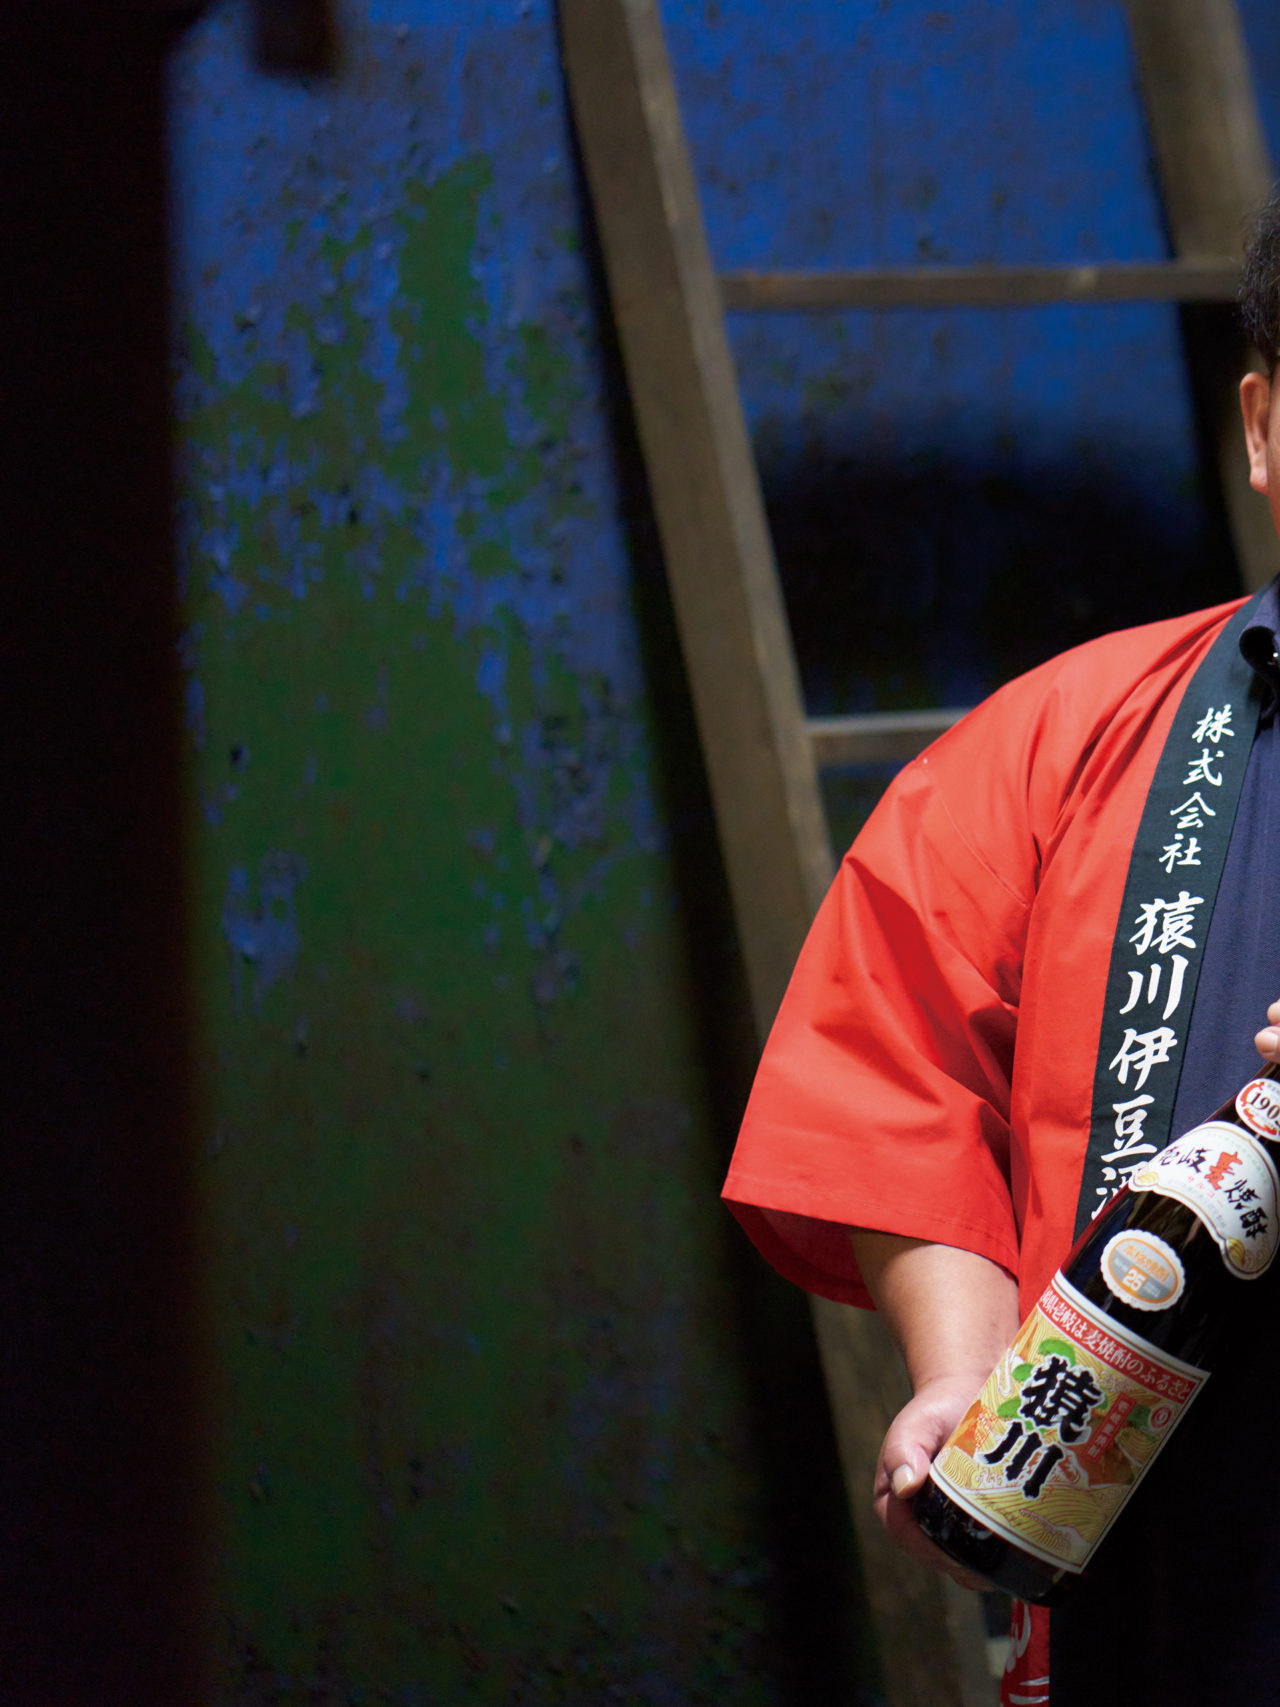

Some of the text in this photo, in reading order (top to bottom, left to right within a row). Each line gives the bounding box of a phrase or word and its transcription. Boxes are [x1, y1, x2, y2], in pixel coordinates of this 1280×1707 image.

[1158, 703, 1235, 874] 株式会社
[1121, 1267, 1148, 1292] 25
[981, 1355, 1104, 1500] 猿川
